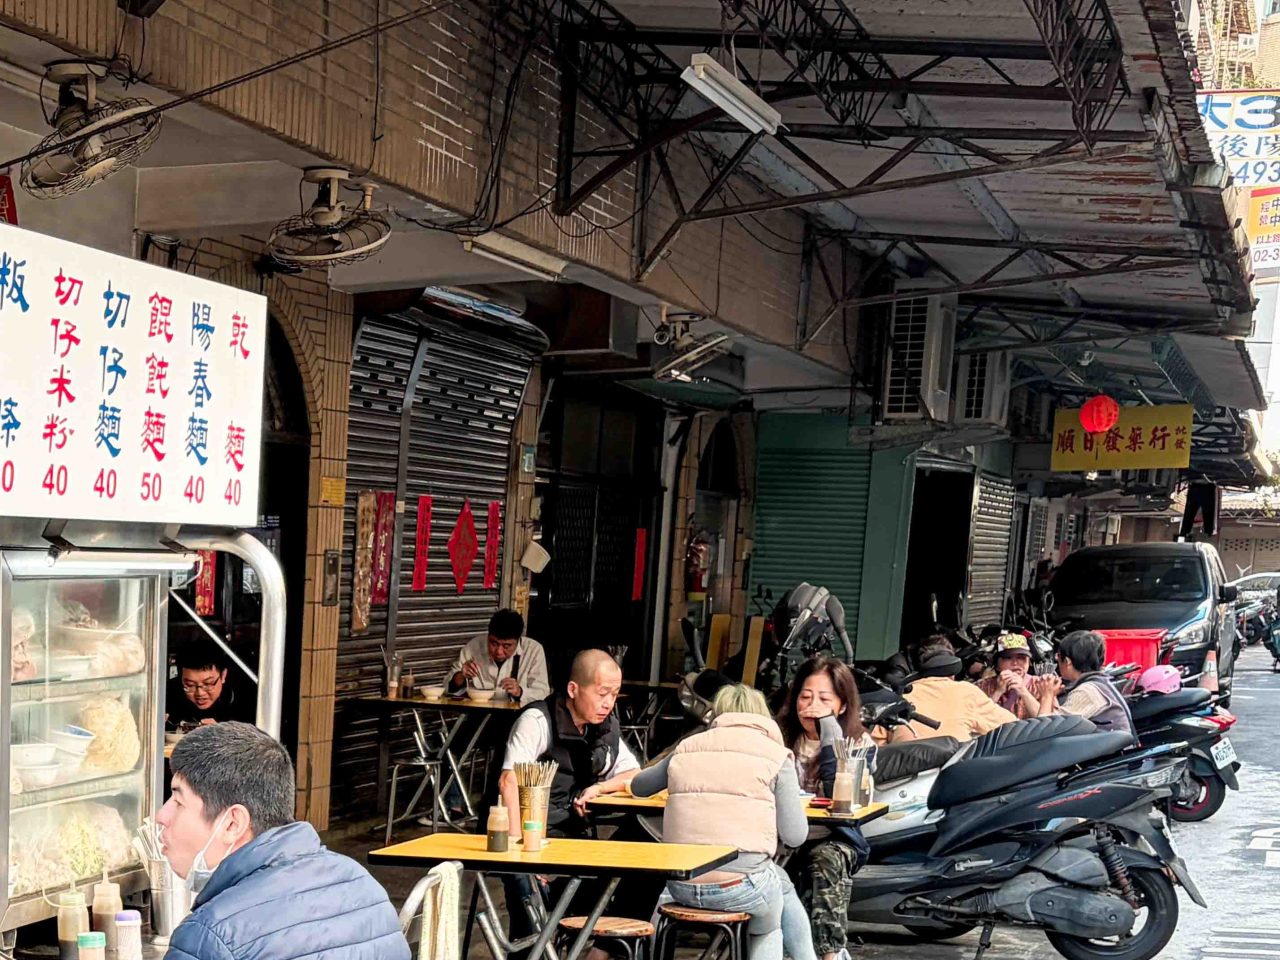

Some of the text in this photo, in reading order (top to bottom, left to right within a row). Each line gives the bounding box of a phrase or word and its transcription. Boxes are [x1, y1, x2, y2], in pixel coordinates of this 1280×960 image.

[42, 268, 83, 496] 切仔米粉 40
[94, 280, 130, 499] 切仔麵 40
[141, 292, 173, 501] 餛飩麵 50
[184, 302, 215, 503] 陽春麵 40
[225, 313, 250, 506] 乾麵 40
